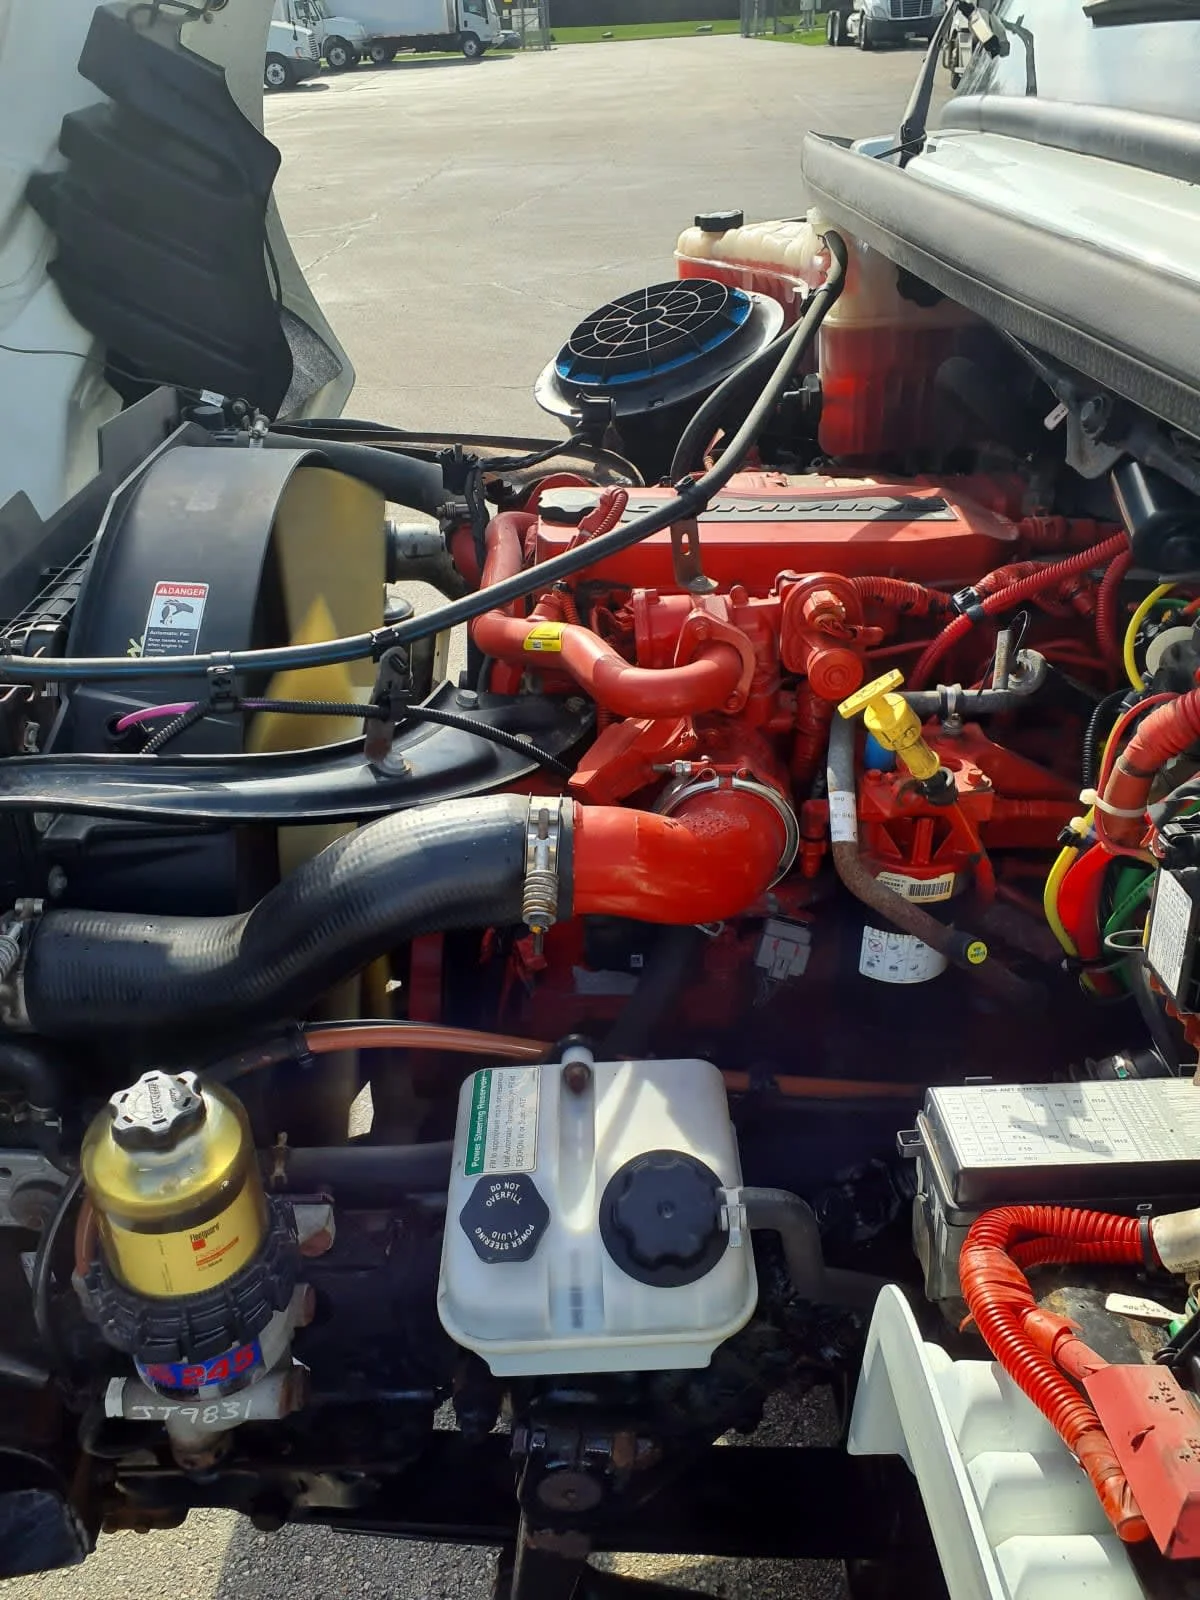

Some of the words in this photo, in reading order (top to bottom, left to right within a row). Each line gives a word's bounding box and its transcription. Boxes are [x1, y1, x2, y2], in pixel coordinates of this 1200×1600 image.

[168, 587, 205, 596] DANGER
[477, 1075, 488, 1109] Reservoir
[474, 1110, 486, 1141] Steering
[472, 1143, 481, 1167] Power
[485, 1191, 522, 1207] OVERFILL
[490, 1183, 501, 1193] DO
[504, 1181, 520, 1191] NOT
[474, 1226, 509, 1250] STEERING
[491, 1229, 519, 1240] FLUID
[511, 1223, 535, 1248] POWER
[182, 1342, 255, 1386] 245
